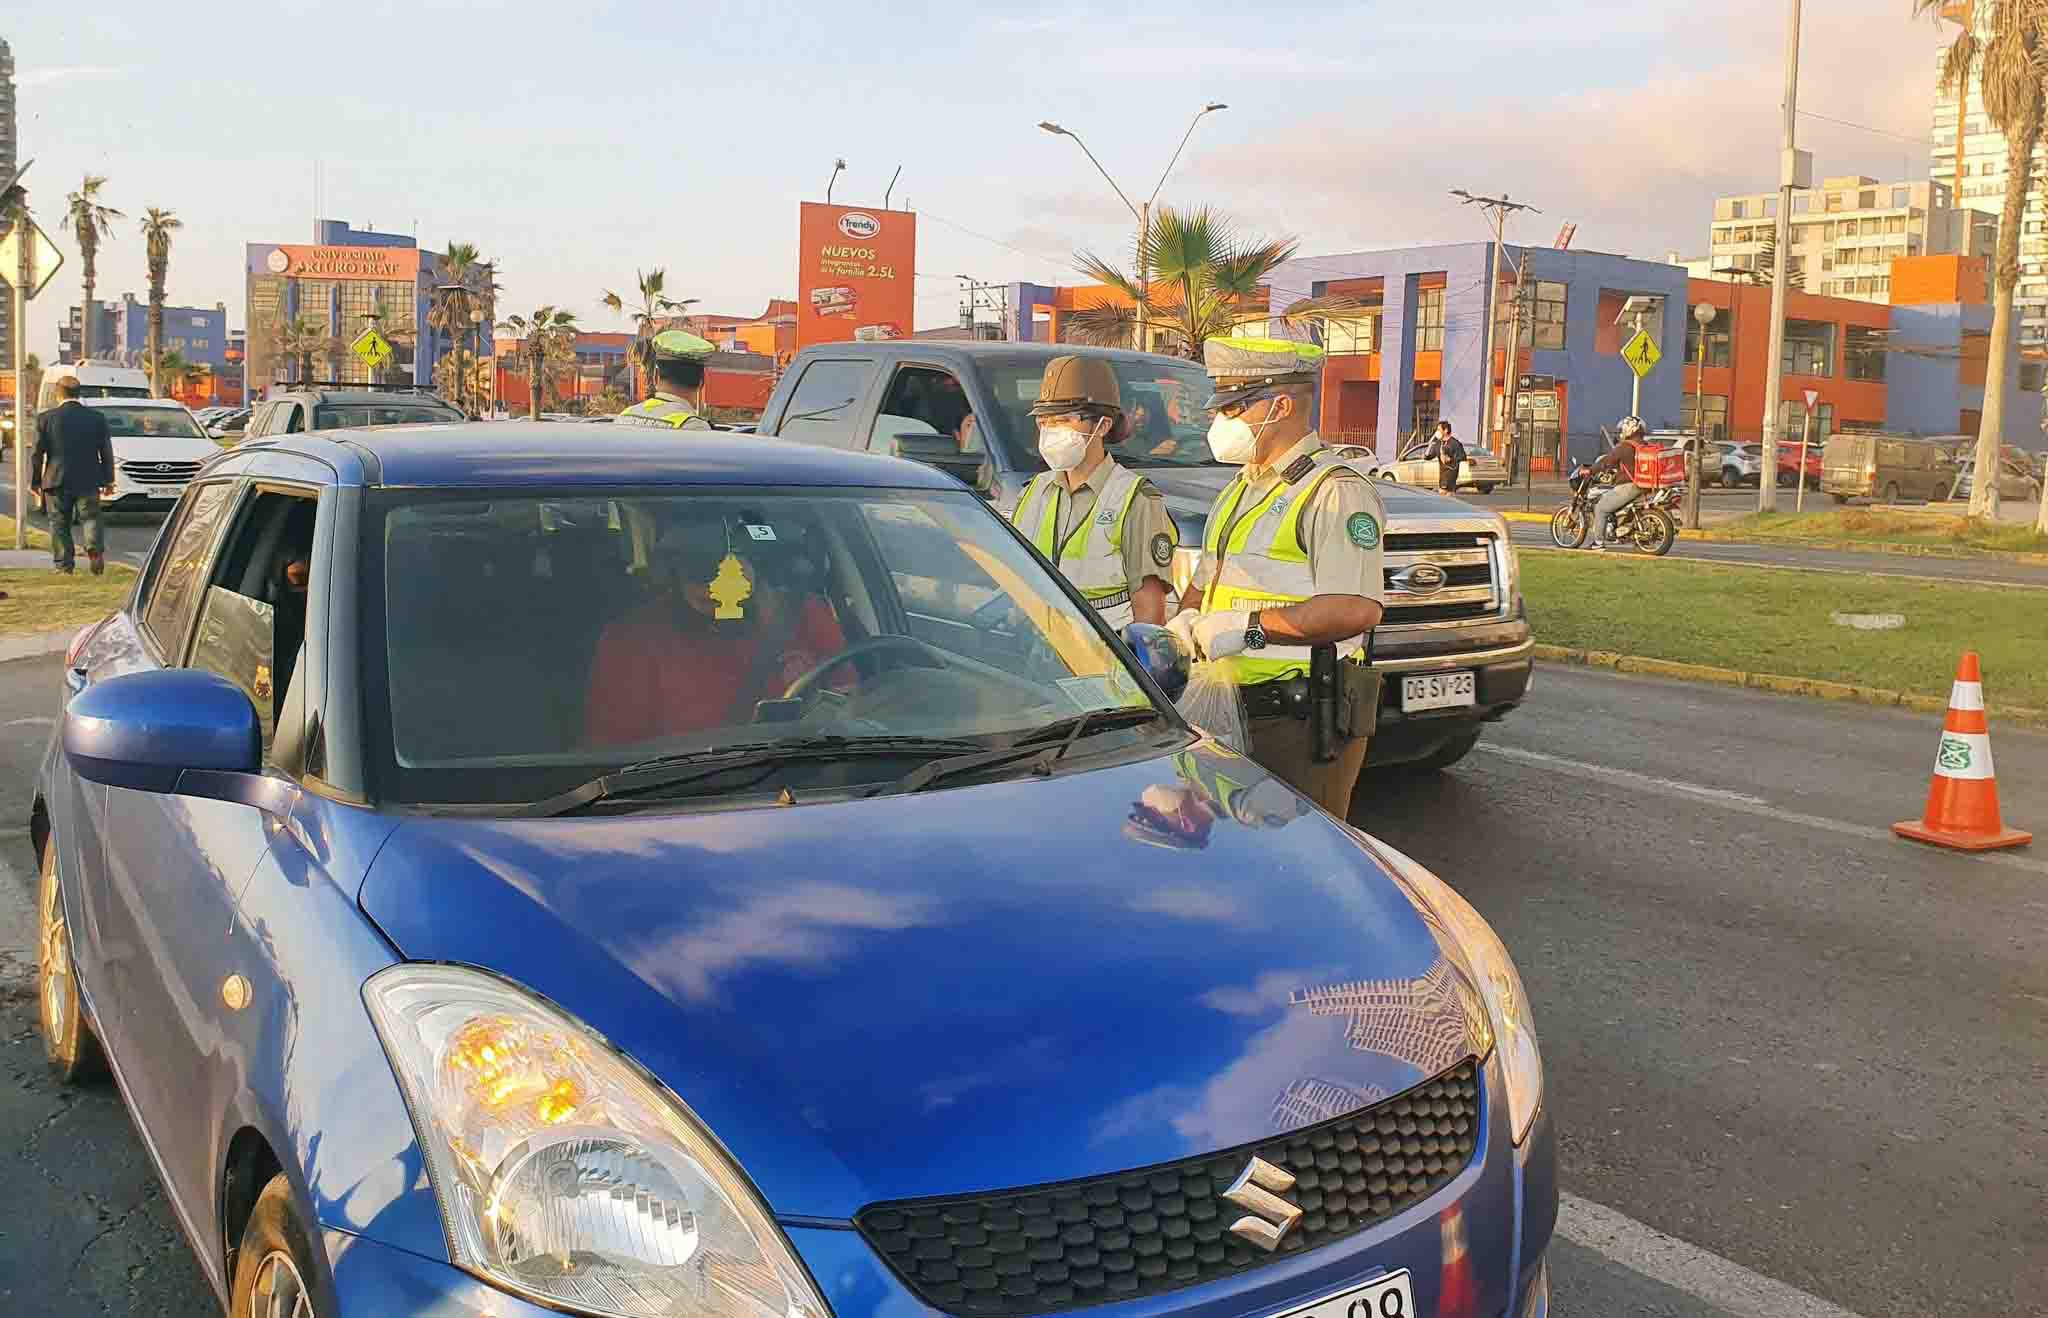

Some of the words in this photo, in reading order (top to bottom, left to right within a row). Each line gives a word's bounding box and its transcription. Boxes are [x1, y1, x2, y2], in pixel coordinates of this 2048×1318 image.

[844, 218, 875, 232] Trendy
[821, 245, 877, 261] NUEVOS
[867, 264, 896, 279] 2.5L
